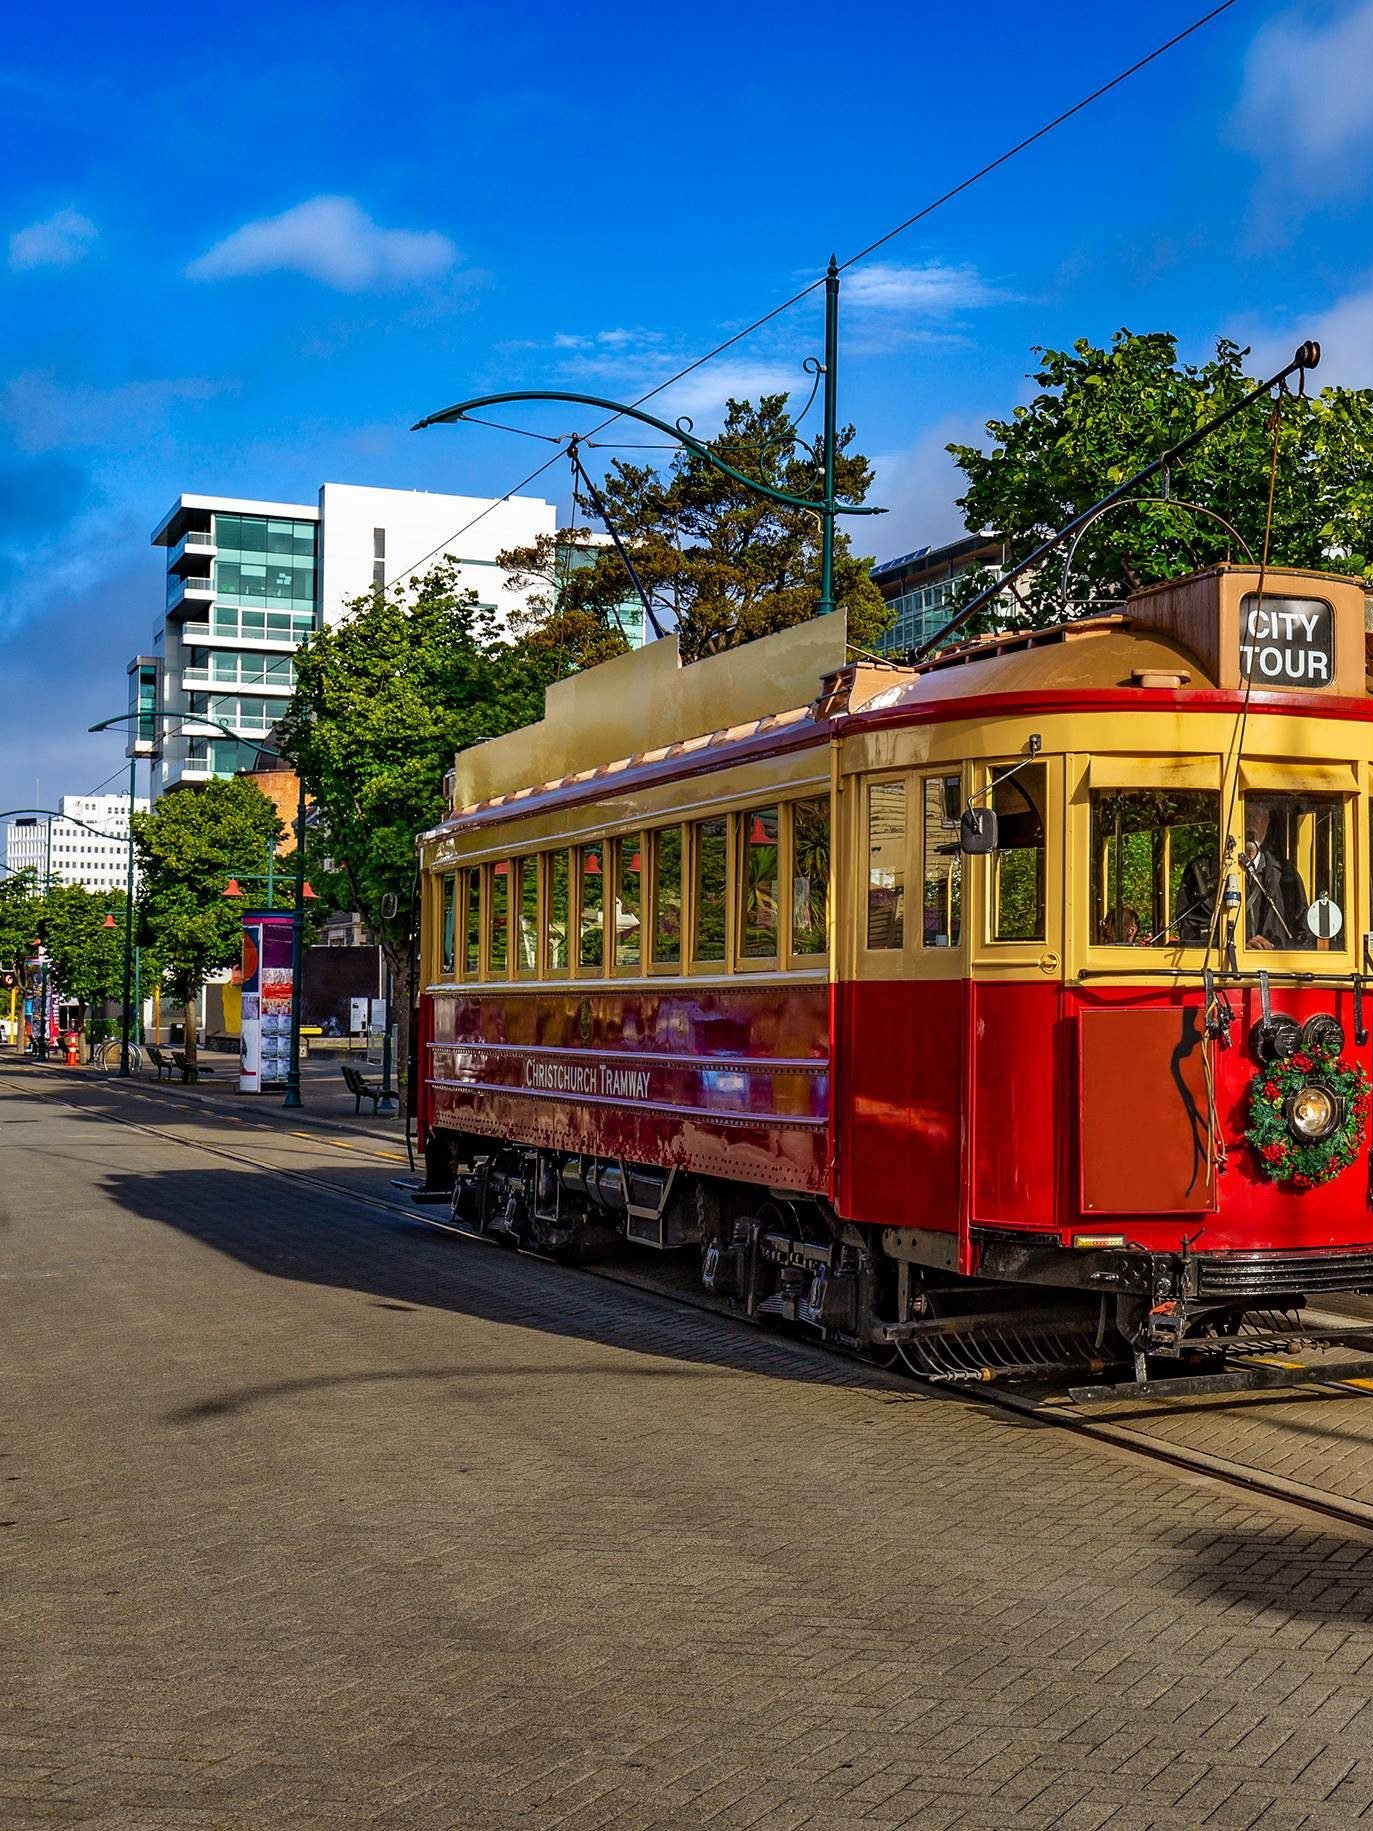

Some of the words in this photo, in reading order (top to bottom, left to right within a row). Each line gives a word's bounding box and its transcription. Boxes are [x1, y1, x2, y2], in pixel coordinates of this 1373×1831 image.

[1247, 609, 1320, 642] CITY
[1239, 645, 1328, 680] TOUR
[525, 1058, 597, 1094] CHRISTCHURCH
[599, 1064, 650, 1099] TRAMWAY
